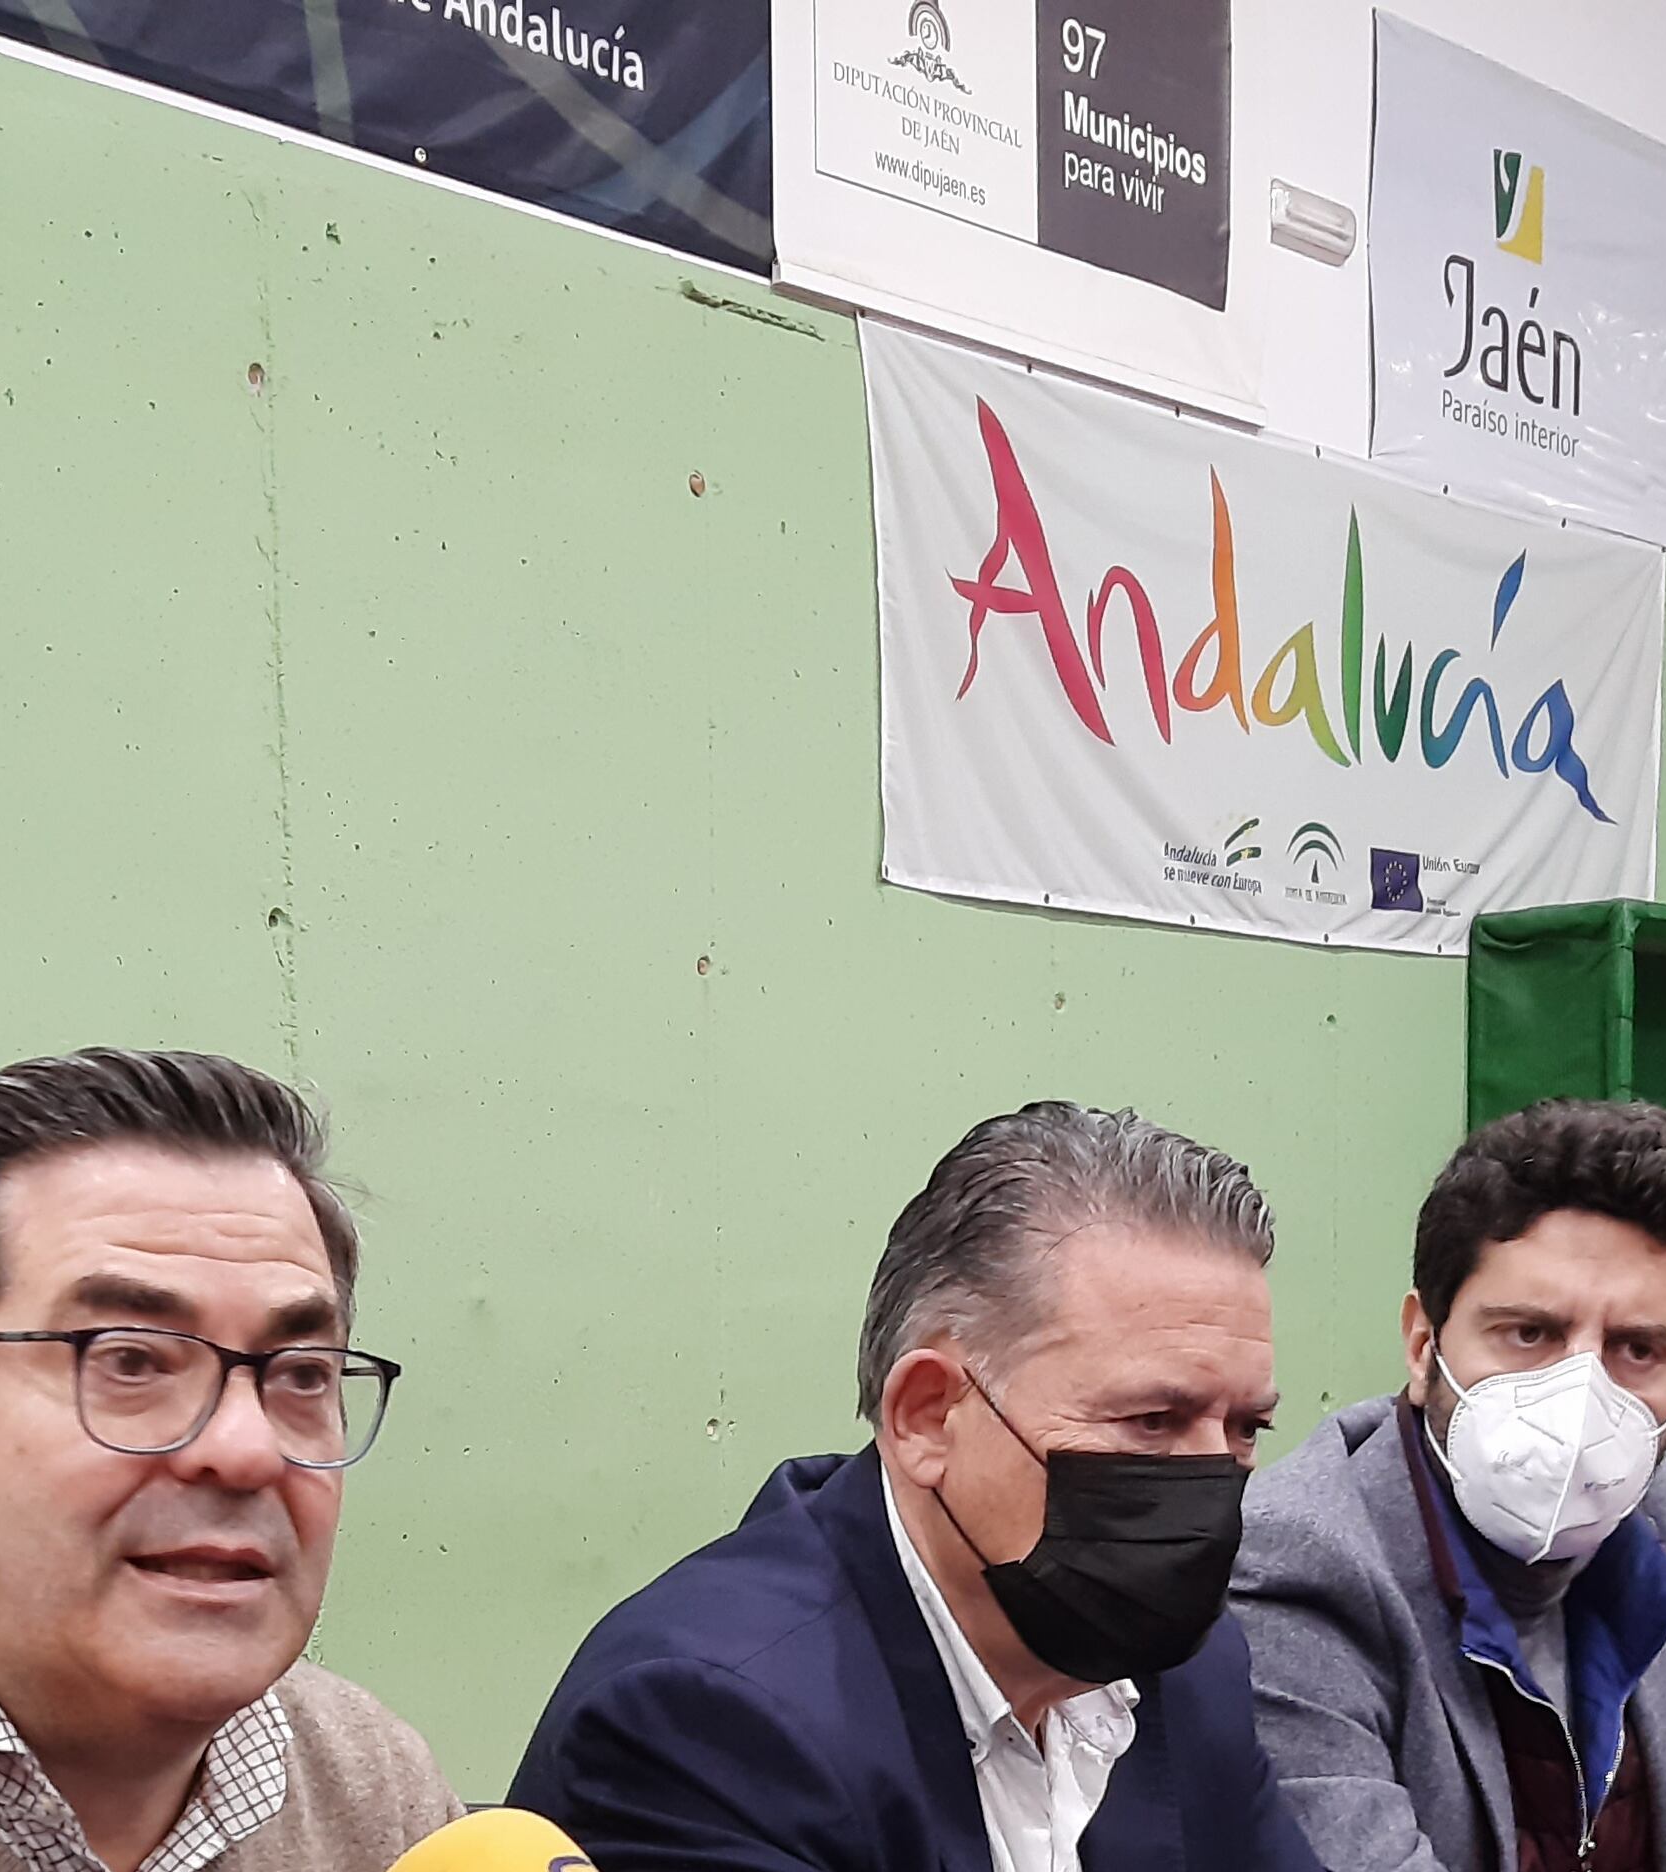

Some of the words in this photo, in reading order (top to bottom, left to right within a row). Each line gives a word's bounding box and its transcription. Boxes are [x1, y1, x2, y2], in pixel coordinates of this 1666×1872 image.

[443, 0, 645, 91] Andalucía
[1061, 17, 1107, 80] 97
[833, 61, 930, 119] DIPUTACIÓN
[933, 98, 1023, 149] PROVINCIAL
[901, 117, 922, 139] DE
[924, 122, 960, 155] JAÉN
[1063, 91, 1206, 185] Municipios
[874, 151, 986, 206] www.dipujaen.es
[1064, 150, 1116, 197] para
[1120, 168, 1165, 214] vivir
[1443, 254, 1581, 417] Jaén
[1442, 389, 1508, 437] Paraíso
[1514, 414, 1580, 460] interior
[945, 394, 1617, 825] Andalucía
[1163, 865, 1176, 882] se
[1211, 872, 1232, 889] con
